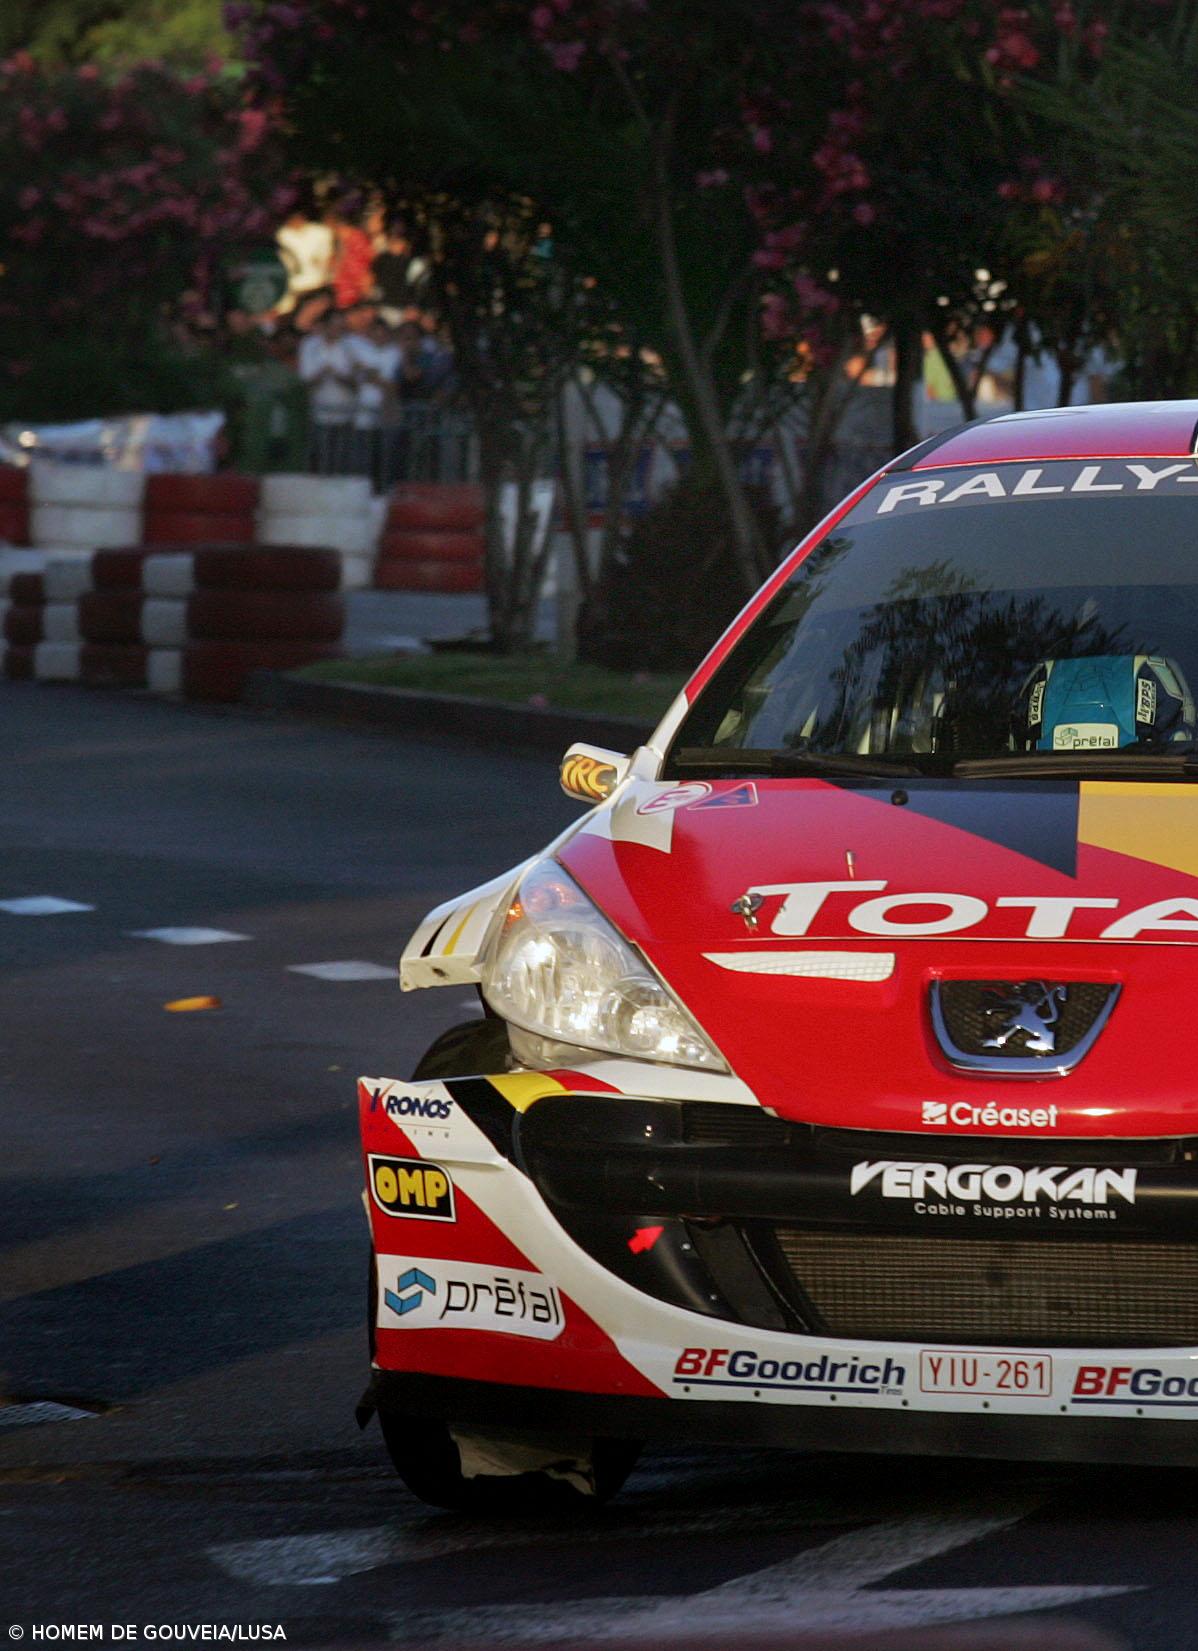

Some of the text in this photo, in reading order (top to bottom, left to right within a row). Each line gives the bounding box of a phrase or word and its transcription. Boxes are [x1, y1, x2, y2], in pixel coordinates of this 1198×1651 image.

[950, 1102, 1058, 1127] Créaset
[376, 1166, 448, 1208] OMP
[850, 1161, 1138, 1204] VERGOKAN
[914, 1202, 1117, 1220] Cable Support Systems
[674, 1348, 906, 1386] BFGoodrich
[928, 1356, 1044, 1389] YIU-261
